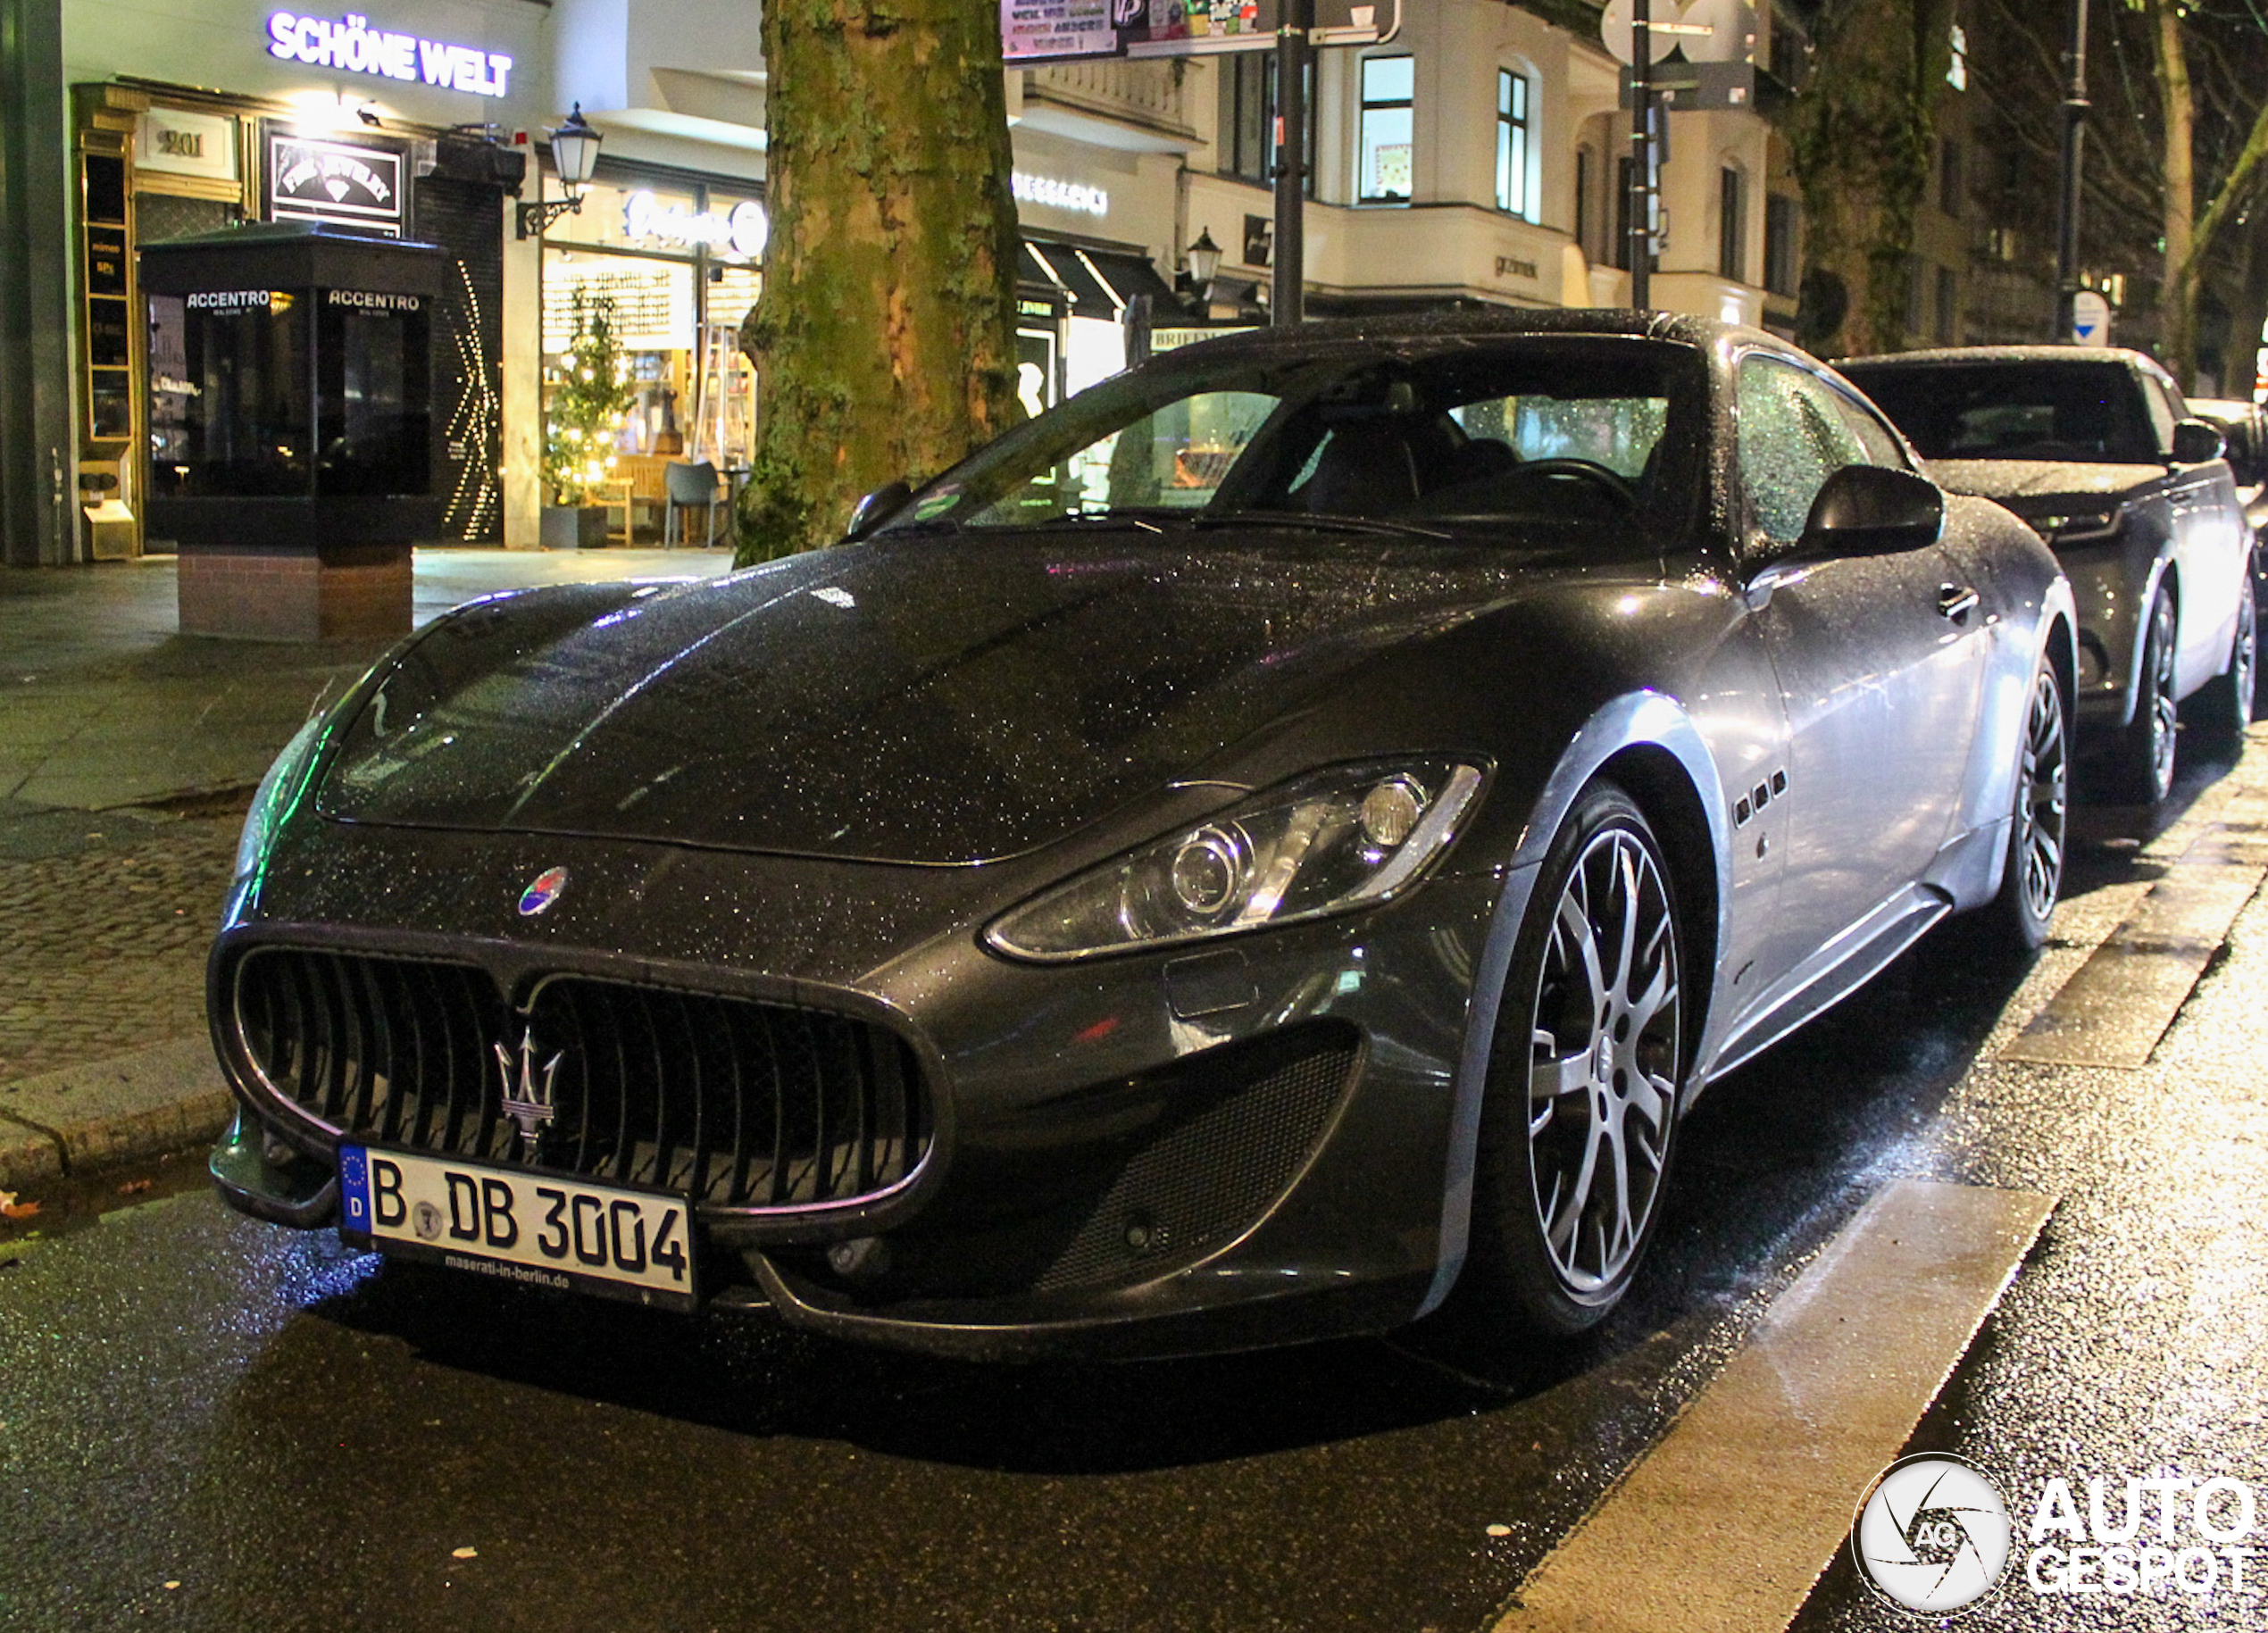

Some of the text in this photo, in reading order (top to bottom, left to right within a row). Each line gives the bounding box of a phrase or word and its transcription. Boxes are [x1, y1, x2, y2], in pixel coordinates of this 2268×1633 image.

[268, 12, 513, 98] SCHÖNE WELT
[157, 130, 204, 157] 201
[187, 289, 270, 309] ACCENTRO
[328, 289, 421, 311] ACCENTRO
[351, 1197, 363, 1217] D
[372, 1158, 687, 1281] B DB 3004
[445, 1254, 571, 1288] maserati-in-berlin.de
